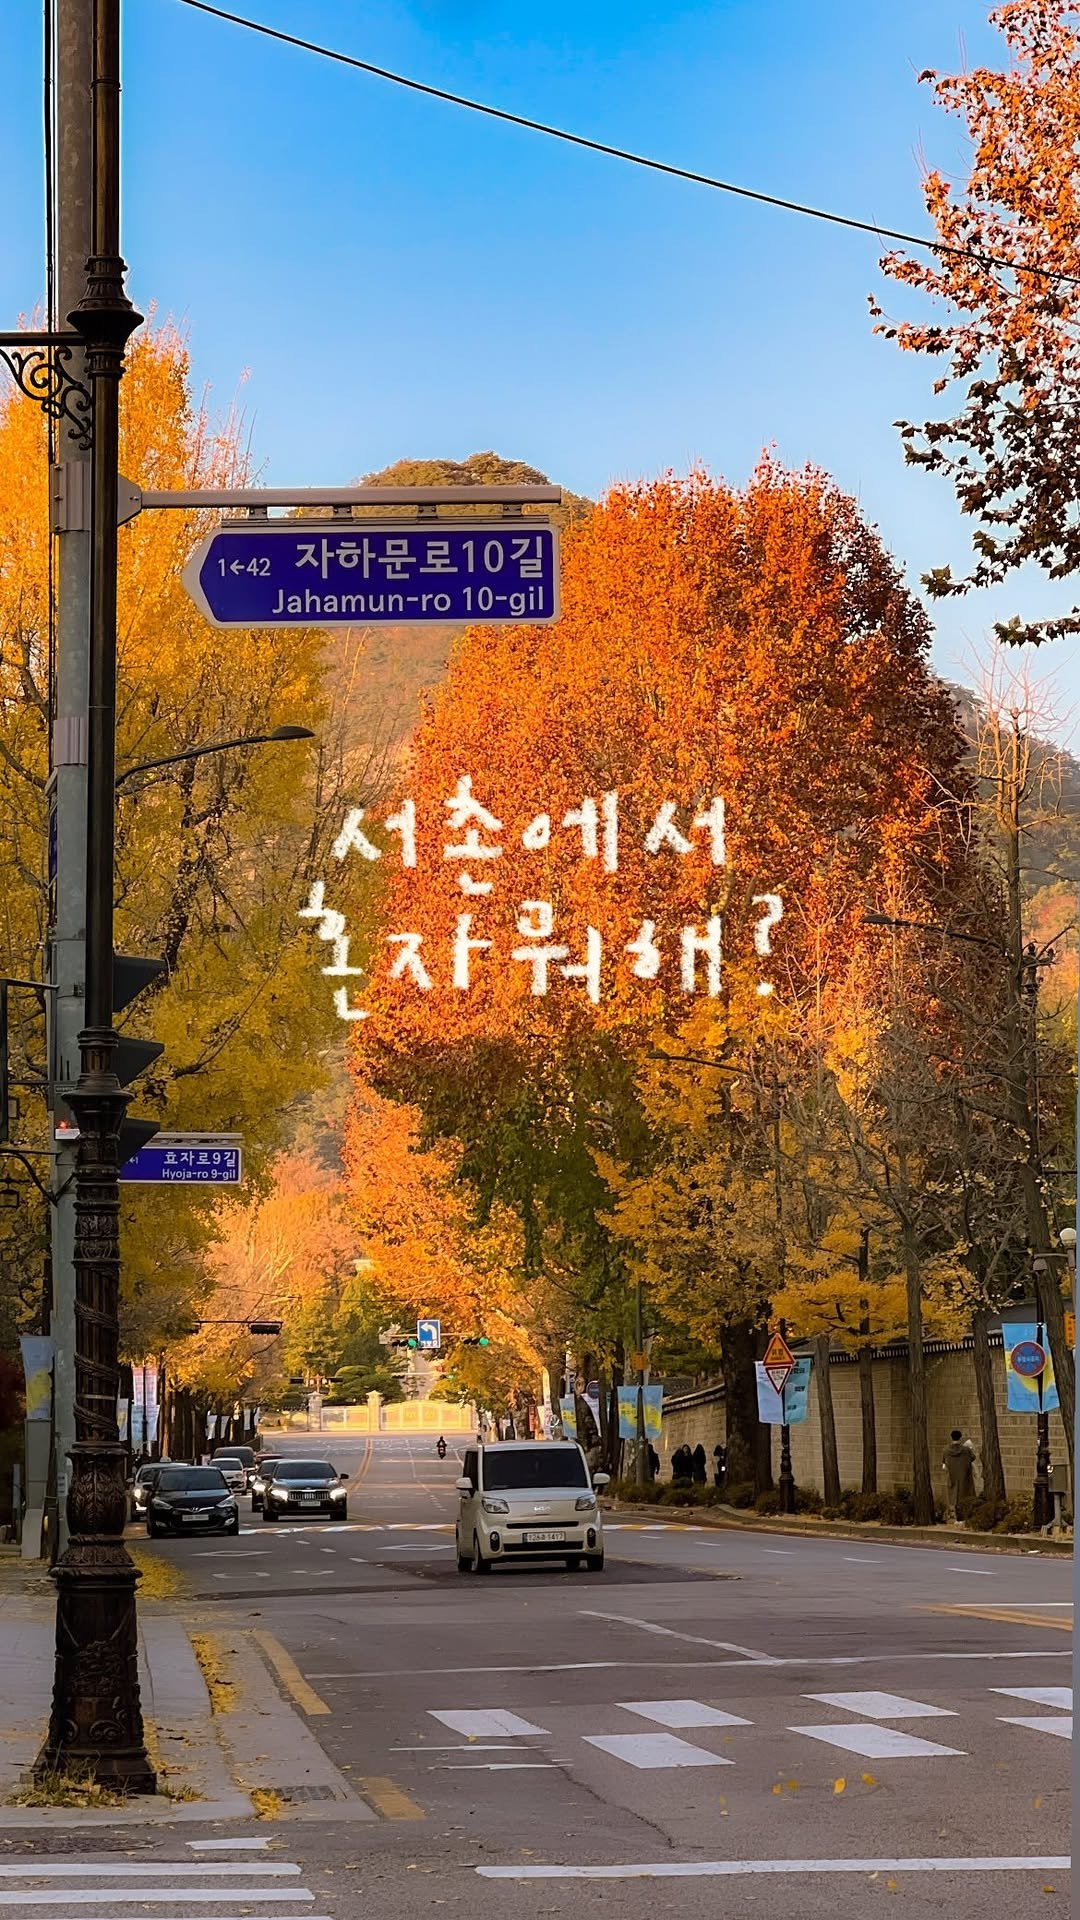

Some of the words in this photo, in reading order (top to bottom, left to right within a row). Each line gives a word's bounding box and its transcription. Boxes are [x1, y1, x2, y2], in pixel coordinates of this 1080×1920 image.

[295, 536, 544, 580] 자하문로10길
[272, 588, 451, 614] Jahamun-ro
[463, 585, 544, 616] 10-gil
[163, 1150, 236, 1168] 효자로9길
[162, 1168, 209, 1180] Hyoja-ro
[210, 1168, 236, 1180] 9-gil
